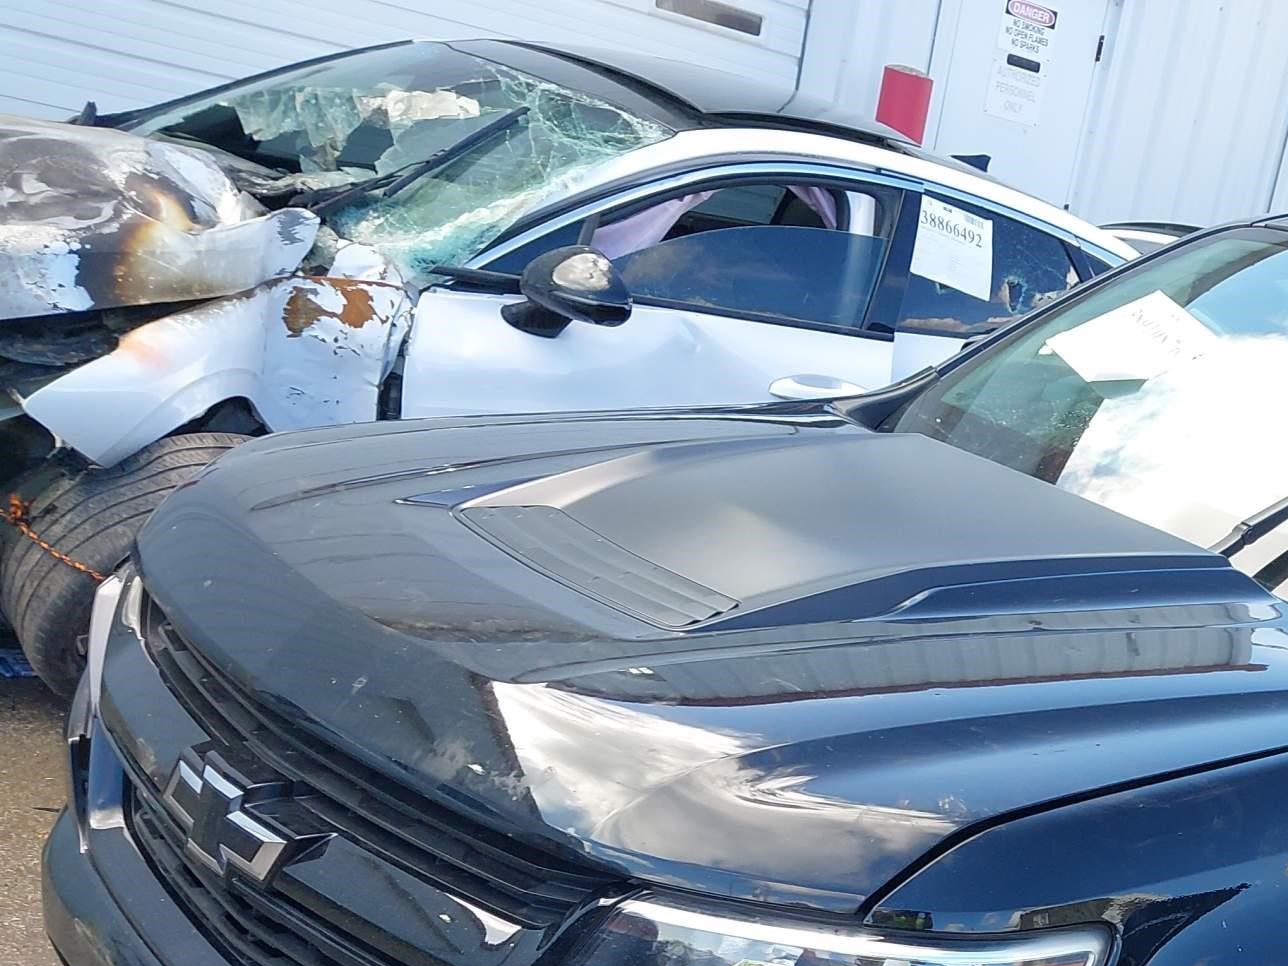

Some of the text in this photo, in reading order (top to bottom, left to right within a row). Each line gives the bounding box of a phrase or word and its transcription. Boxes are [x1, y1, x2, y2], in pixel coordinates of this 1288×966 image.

[1013, 2, 1050, 24] DANGER
[1013, 19, 1022, 28] NO
[1006, 26, 1048, 47] NO OPEN FLAMES
[1011, 38, 1019, 47] NO
[920, 210, 983, 248] 38866492
